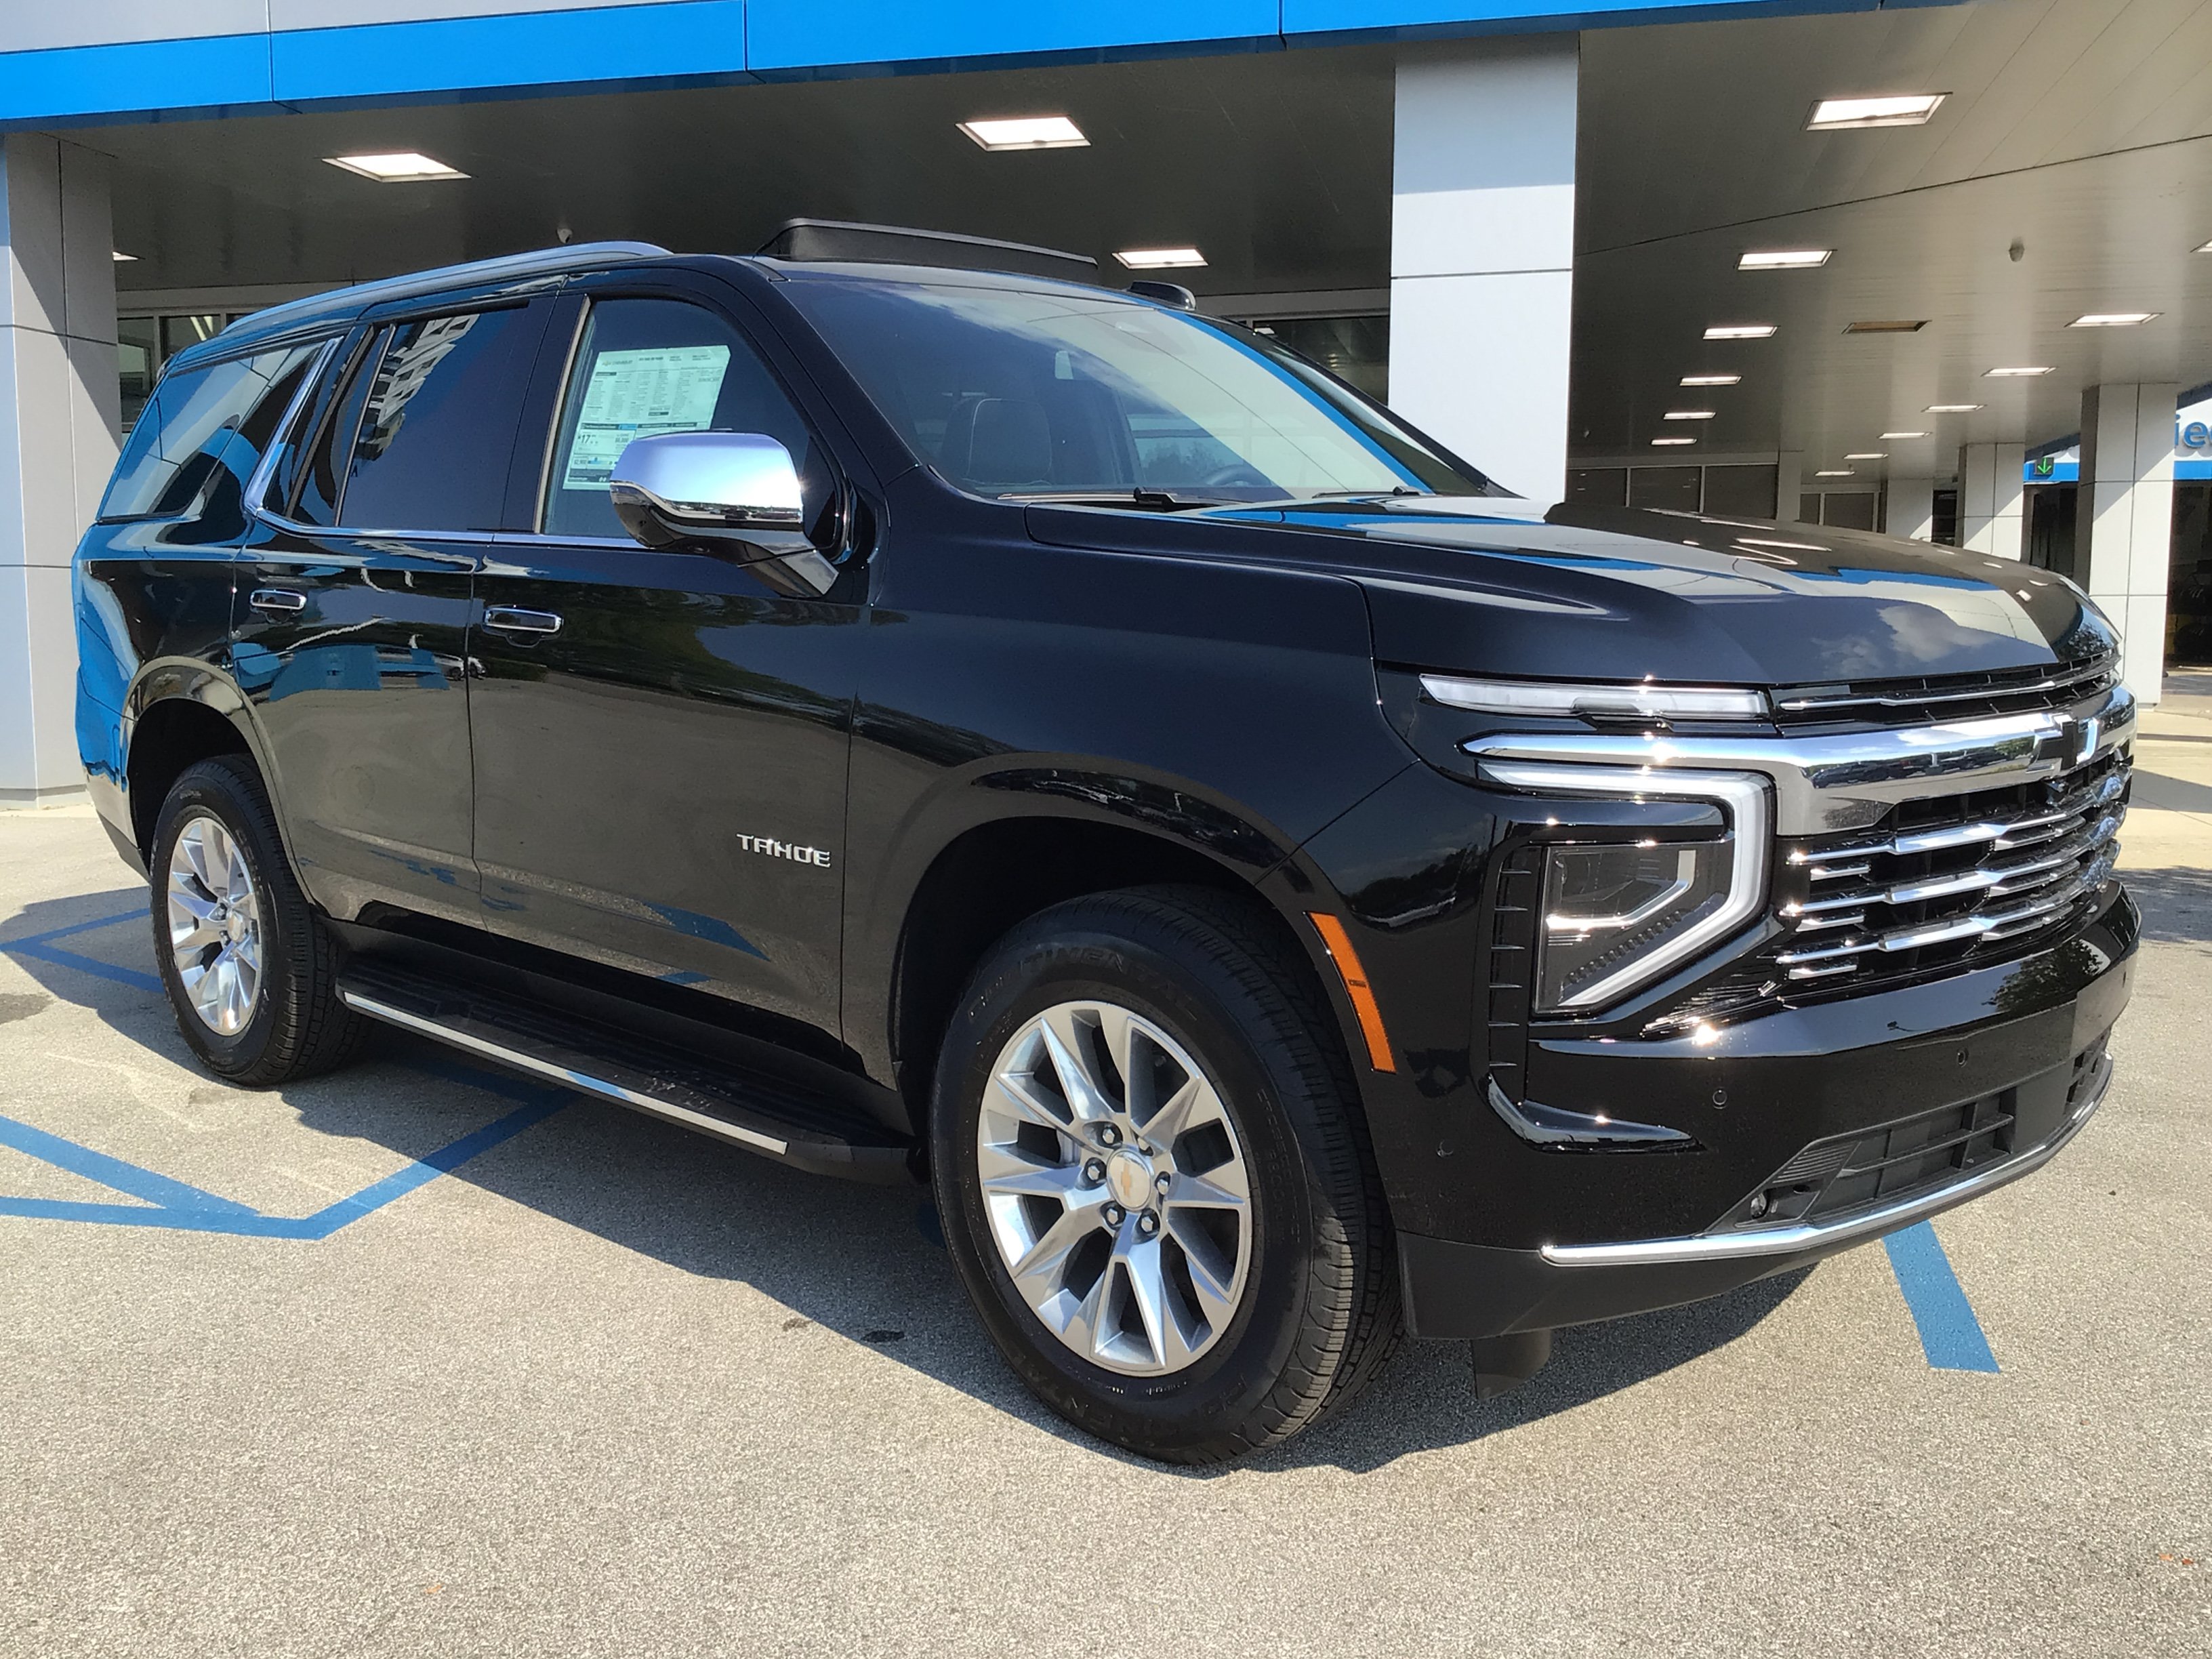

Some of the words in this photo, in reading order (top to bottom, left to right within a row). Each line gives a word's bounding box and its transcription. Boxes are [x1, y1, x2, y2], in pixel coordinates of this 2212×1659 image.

[581, 434, 591, 445] 17
[2175, 413, 2212, 449] ie
[736, 833, 831, 868] TAHOE
